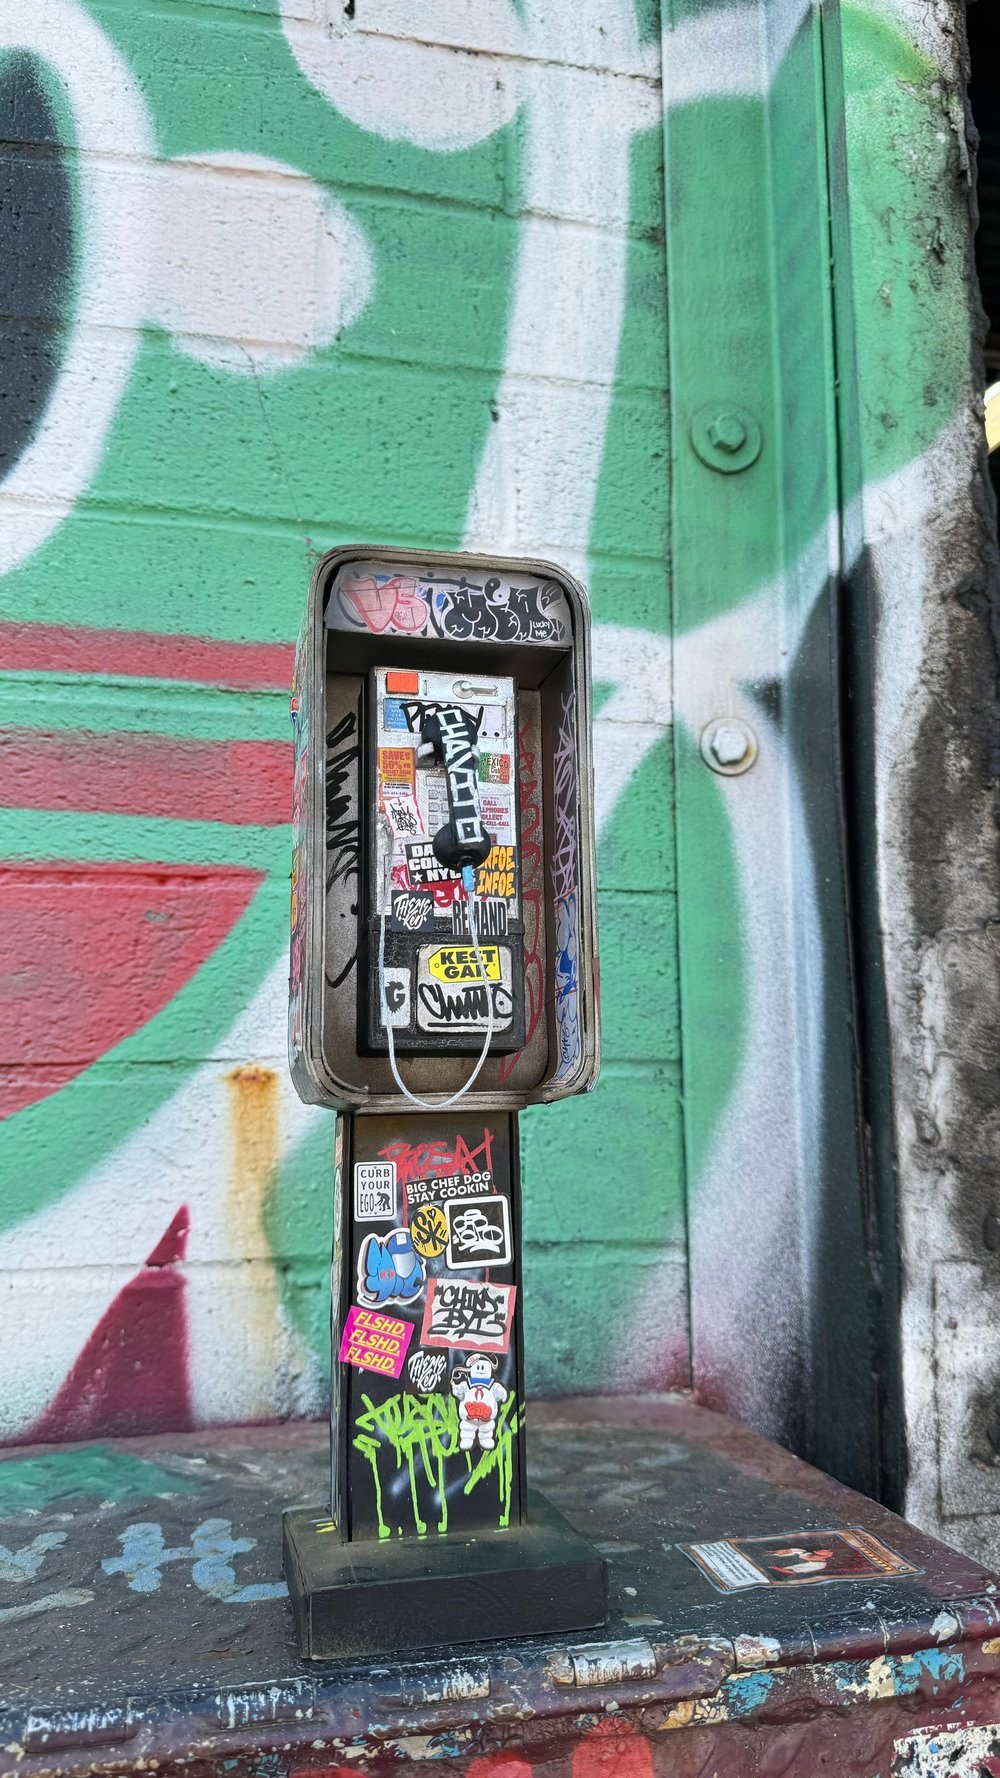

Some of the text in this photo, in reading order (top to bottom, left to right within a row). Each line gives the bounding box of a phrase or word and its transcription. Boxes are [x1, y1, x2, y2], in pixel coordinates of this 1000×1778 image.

[480, 756, 508, 768] MEXICO
[481, 813, 503, 821] OLLECT
[476, 871, 515, 897] INFOE
[440, 949, 496, 965] KEST
[360, 1168, 390, 1179] CURB
[360, 1180, 390, 1190] YOUR
[405, 1171, 491, 1195] BIG CHEF DOG
[407, 1181, 490, 1205] STAY COOKIN
[359, 1192, 375, 1213] EGO
